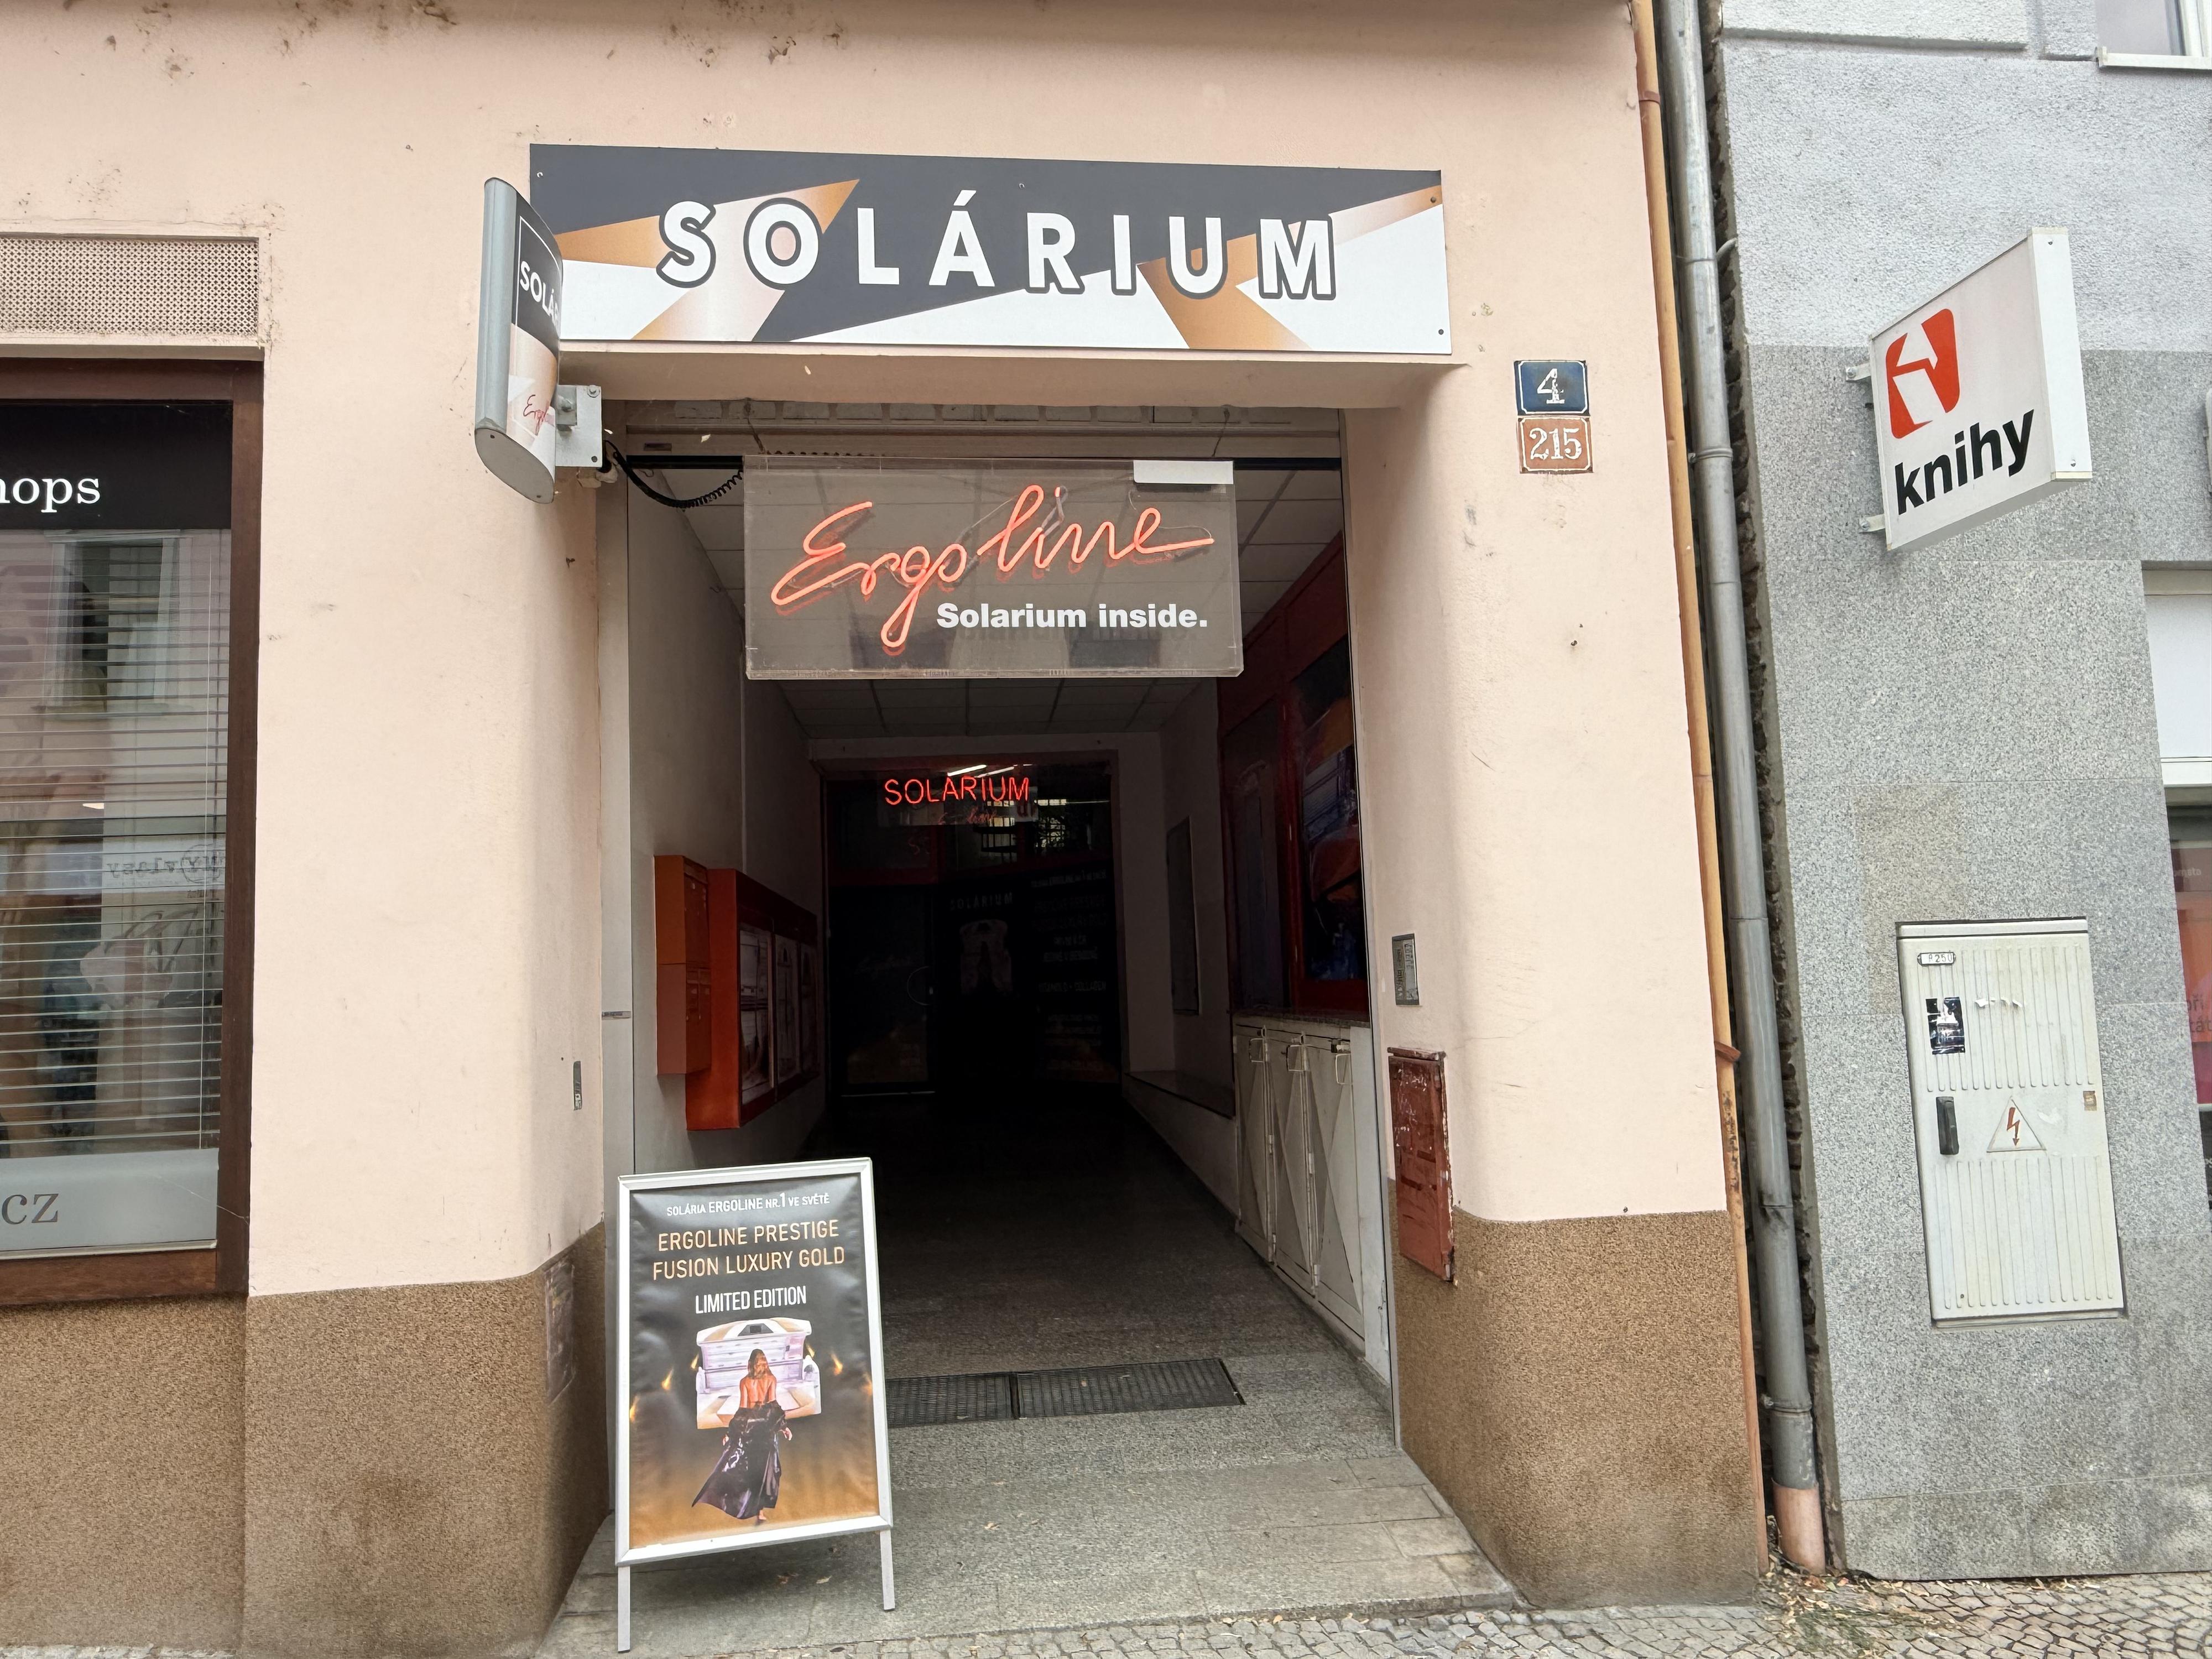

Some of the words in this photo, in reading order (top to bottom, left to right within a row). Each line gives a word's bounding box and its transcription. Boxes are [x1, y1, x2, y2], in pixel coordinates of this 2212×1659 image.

[658, 190, 1335, 299] SOLÁRIUM
[1537, 368, 1564, 404] 4
[1529, 427, 1582, 460] 215
[1895, 409, 2034, 515] knihy
[771, 484, 1214, 648] Ergoline
[937, 603, 1087, 628] Solarium
[1099, 603, 1208, 628] inside.
[884, 775, 1029, 806] SOLARIUM
[667, 1203, 706, 1216] SOLÁRIA
[708, 1198, 763, 1213] ERGOLINE
[788, 1197, 800, 1206] VE
[658, 1227, 747, 1251] ERGOLINE
[754, 1219, 839, 1243] PRESTIGE
[653, 1257, 718, 1280] FUSION
[726, 1251, 793, 1274] LUXURY
[799, 1246, 845, 1267] GOLD
[695, 1291, 750, 1314] LIMITED
[754, 1285, 807, 1308] EDITION
